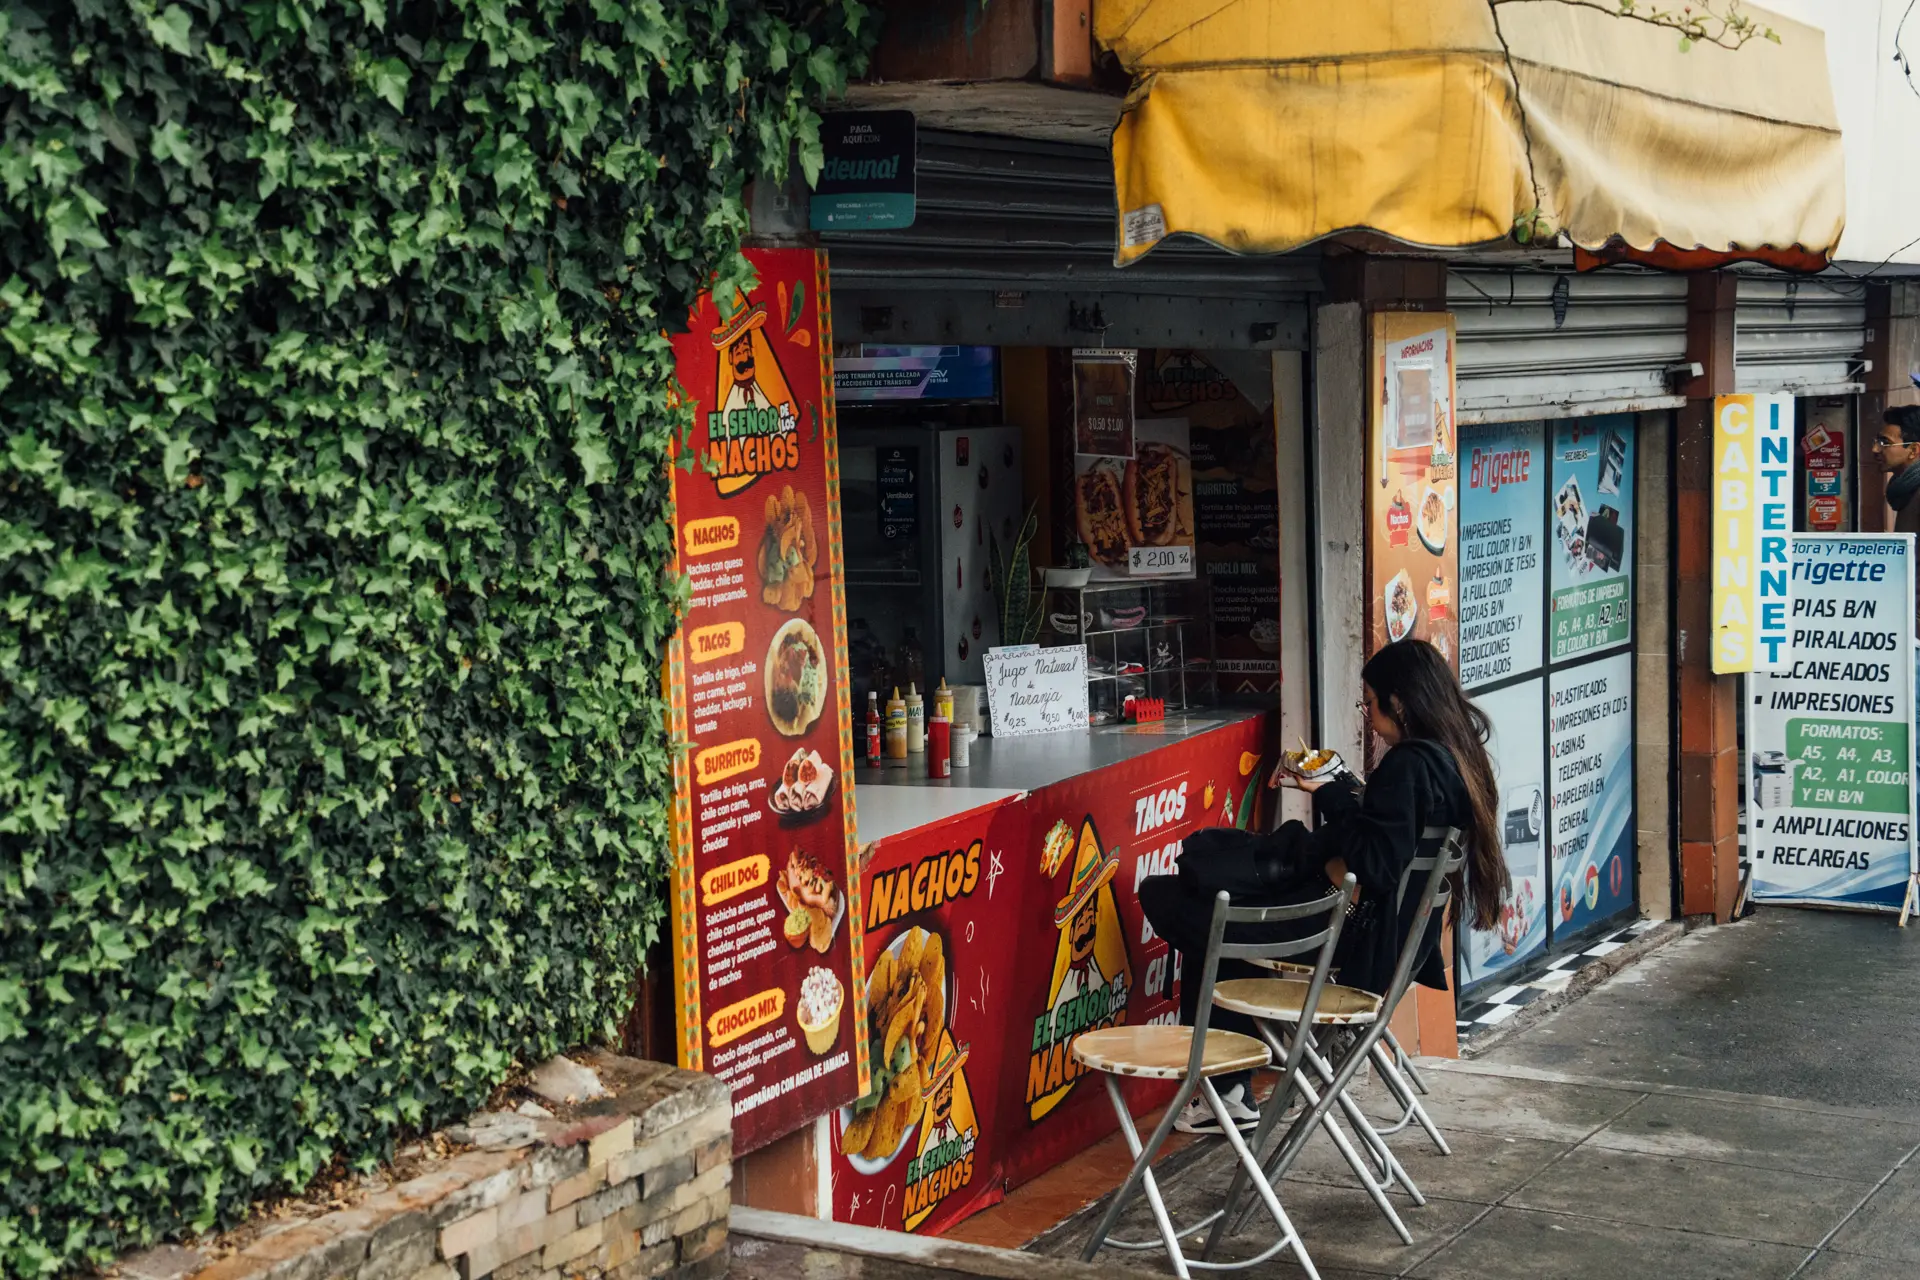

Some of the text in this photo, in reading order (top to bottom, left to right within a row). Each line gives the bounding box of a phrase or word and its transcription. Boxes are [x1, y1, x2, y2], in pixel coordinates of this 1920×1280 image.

[850, 125, 872, 134] PAGA
[708, 401, 779, 438] EL SEÑOR
[780, 402, 790, 416] DE
[781, 416, 795, 431] LOS
[709, 433, 799, 478] NACHOS
[1470, 446, 1531, 494] Brigette
[1197, 482, 1238, 495] BURRITOS
[693, 523, 735, 546] NACHOS
[1462, 519, 1512, 542] IMPRESIONES
[1720, 402, 1749, 664] CABINAS
[1760, 403, 1788, 664] INTERNET
[1133, 551, 1174, 568] $ 2,00
[1467, 535, 1532, 561] FULL COLOR Y B/N
[1826, 545, 1834, 556] y
[686, 558, 743, 575] Nachos con queso
[1206, 562, 1258, 574] CHOCLO MIX
[1462, 554, 1536, 582] IMPRESIÓN DE TESIS
[1792, 559, 1886, 585] rigette
[716, 573, 743, 587] chile con
[1462, 587, 1468, 604] A
[1469, 582, 1488, 600] FULL
[1489, 578, 1513, 596] COLOR
[707, 586, 748, 608] y guacamole.
[1588, 588, 1595, 604] DE
[1461, 600, 1504, 624] COPIAS B/N
[1843, 600, 1877, 619] B/N
[1461, 614, 1523, 645] AMPLIACIONES Y
[1557, 613, 1596, 636] A5, A4, A3,
[698, 630, 731, 653] TACOS
[1461, 637, 1511, 665] REDUCCIONES
[1557, 628, 1608, 655] EN COLOR Y B/N
[1793, 630, 1897, 651] PIRALADOS
[692, 661, 756, 686] Tortilla de trigo, chile
[998, 656, 1078, 688] Jugo Natural
[1231, 662, 1276, 670] DE JAMAICA
[1461, 656, 1512, 686] ESPIRALADOS
[693, 682, 746, 702] con carne, queso
[1027, 681, 1035, 689] de
[1555, 678, 1608, 709] PLASTIFICADOS
[694, 696, 752, 719] cheddar, lechuga y
[1010, 688, 1062, 713] Naranja
[1770, 691, 1894, 714] IMPRESIONES
[695, 720, 717, 734] tomate
[1555, 699, 1611, 734] IMPRESIONES EN
[1800, 723, 1884, 741] FORMATOS:
[704, 745, 755, 775] BURRITOS
[1556, 738, 1586, 760] CABINAS
[1801, 745, 1896, 765] A5, A4, A3,
[1558, 753, 1602, 784] TELEFÓNICAS
[1801, 767, 1827, 782] A2,
[1837, 769, 1861, 785] A1,
[700, 778, 766, 805] Tortilla de trigo, arroz,
[1556, 775, 1605, 807] PAPELERÍA EN
[1802, 788, 1865, 804] Y EN B/N
[701, 799, 750, 822] chile con carne,
[1134, 781, 1188, 836] TACOS
[1558, 808, 1589, 835] GENERAL
[702, 810, 761, 840] guacamole y queso
[1772, 815, 1909, 842] AMPLIACIONES
[702, 835, 729, 854] cheddar
[1556, 832, 1589, 861] INTERNET
[1772, 846, 1870, 870] RECARGAS
[710, 863, 759, 894] CHILI DOG
[865, 838, 983, 934] NACHOS
[706, 893, 768, 926] Salchicha artesanal,
[707, 909, 776, 942] chile con carne, queso
[708, 925, 771, 958] cheddar, guacamole,
[708, 938, 777, 975] tomate y acompañado
[709, 970, 742, 991] de nachos
[1112, 973, 1124, 994] DE
[1110, 987, 1127, 1016] LOS
[717, 995, 778, 1036] CHOCLO MIX
[1032, 1012, 1054, 1050] EL
[1054, 983, 1110, 1038] SEÑOR
[713, 1027, 787, 1067] Choclo desgranado, con
[735, 1037, 796, 1074] cheddar, guacamole
[734, 1051, 850, 1117] ACOMPAÑADO CON AGUA DE JAMAICA
[962, 1136, 974, 1157] LOS
[964, 1126, 973, 1141] DE
[906, 1136, 962, 1186] EL SEÑOR
[902, 1151, 974, 1220] NACHOS
